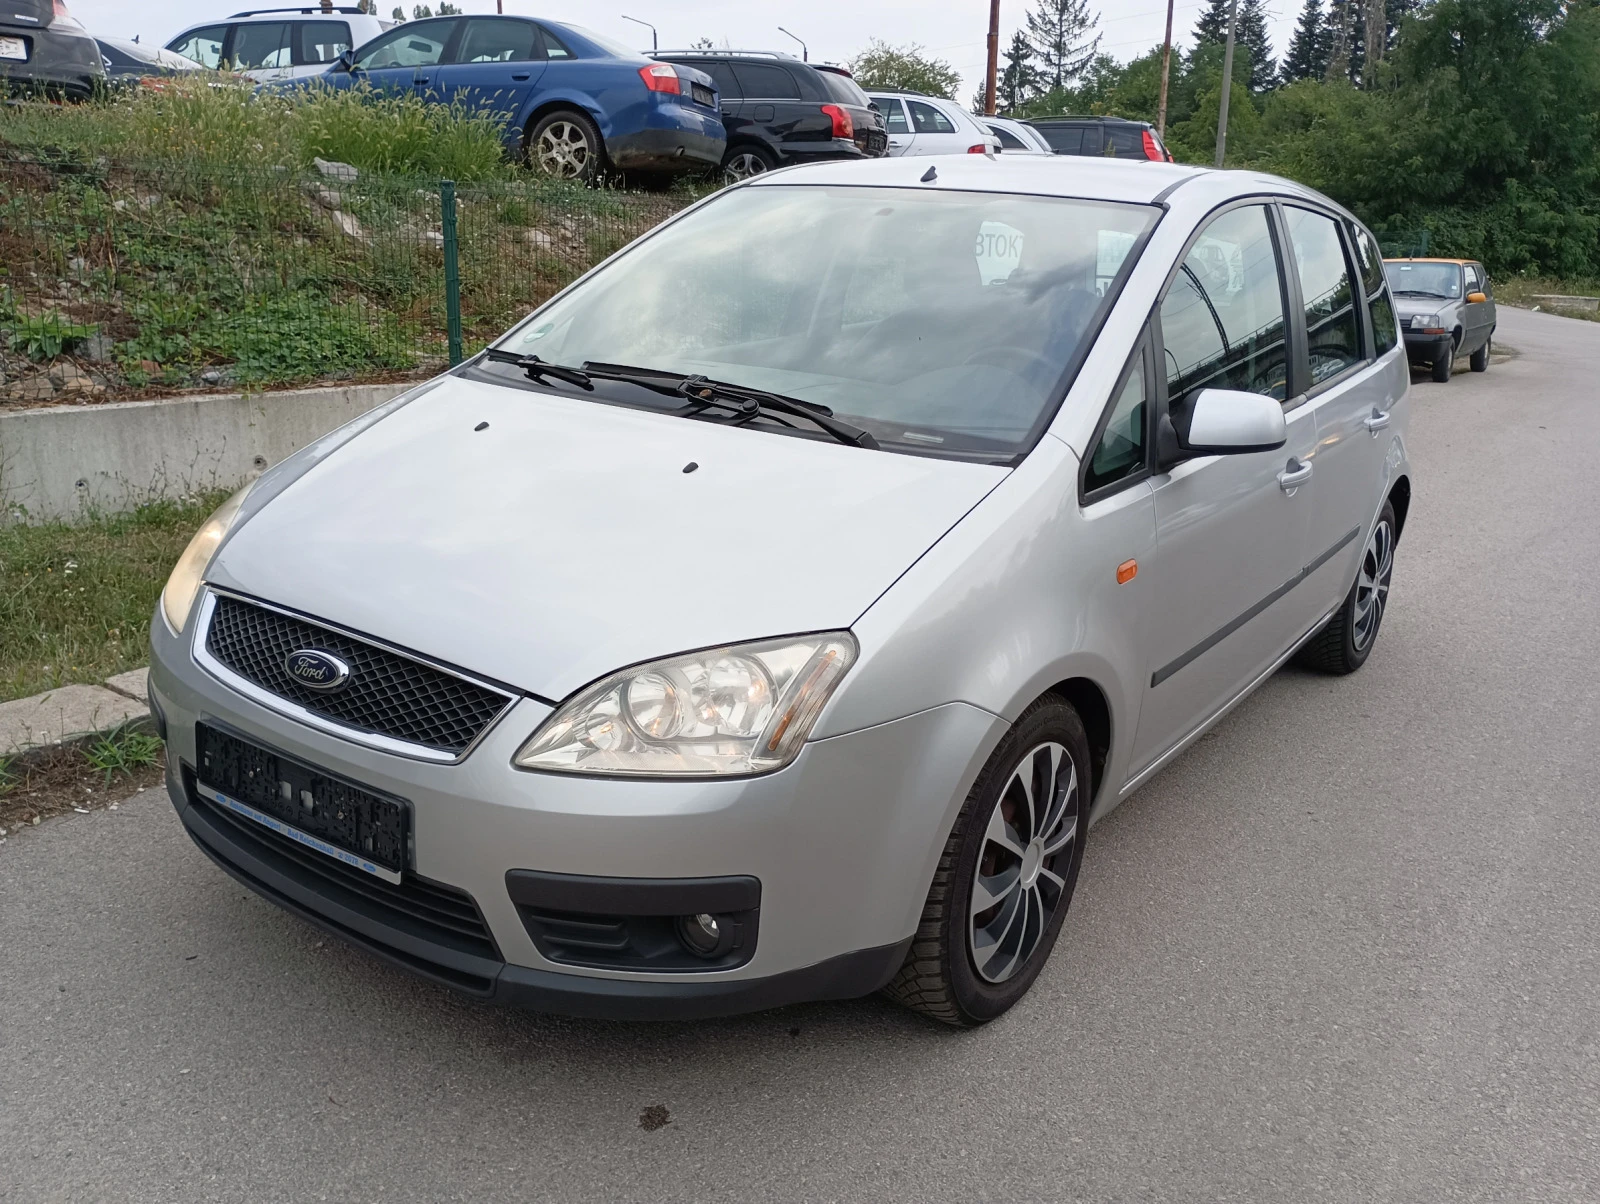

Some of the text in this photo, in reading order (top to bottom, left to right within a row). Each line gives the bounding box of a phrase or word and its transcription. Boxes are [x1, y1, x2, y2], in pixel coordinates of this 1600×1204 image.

[975, 233, 1023, 258] ВТОК
[294, 656, 327, 680] Ford
[287, 829, 298, 839] Bad
[299, 834, 335, 855] Reichenhall
